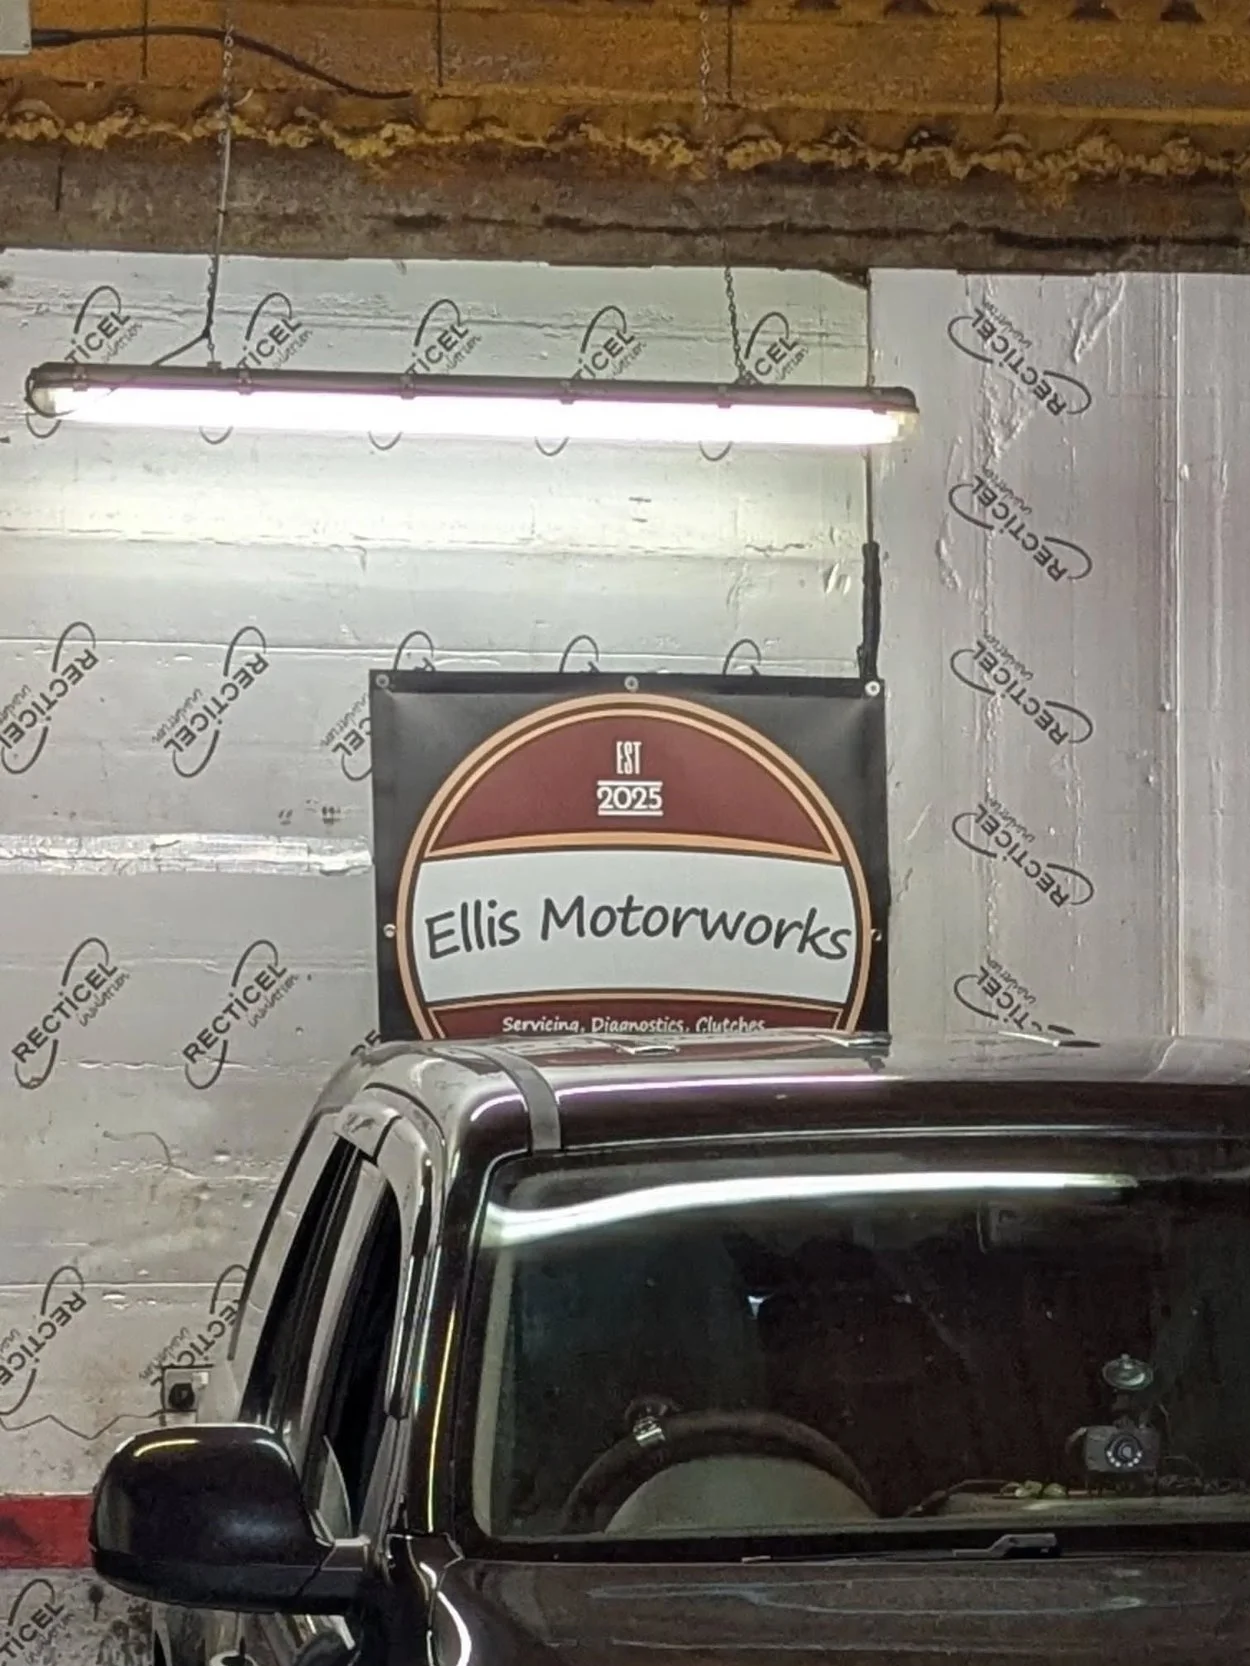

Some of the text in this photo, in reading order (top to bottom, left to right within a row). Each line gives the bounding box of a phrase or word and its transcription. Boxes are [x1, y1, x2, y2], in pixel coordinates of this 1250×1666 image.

[64, 310, 131, 366] TICEL
[237, 316, 302, 370] TICEL
[405, 320, 470, 376] TICEL
[571, 326, 637, 380] TICEL
[616, 741, 642, 775] EST
[597, 786, 663, 811] 2025
[425, 895, 852, 961] Ellis Motorworks
[974, 965, 1042, 1033] TICEL
[0, 1290, 87, 1386] RECTICE
[0, 1602, 64, 1660] TICEL
